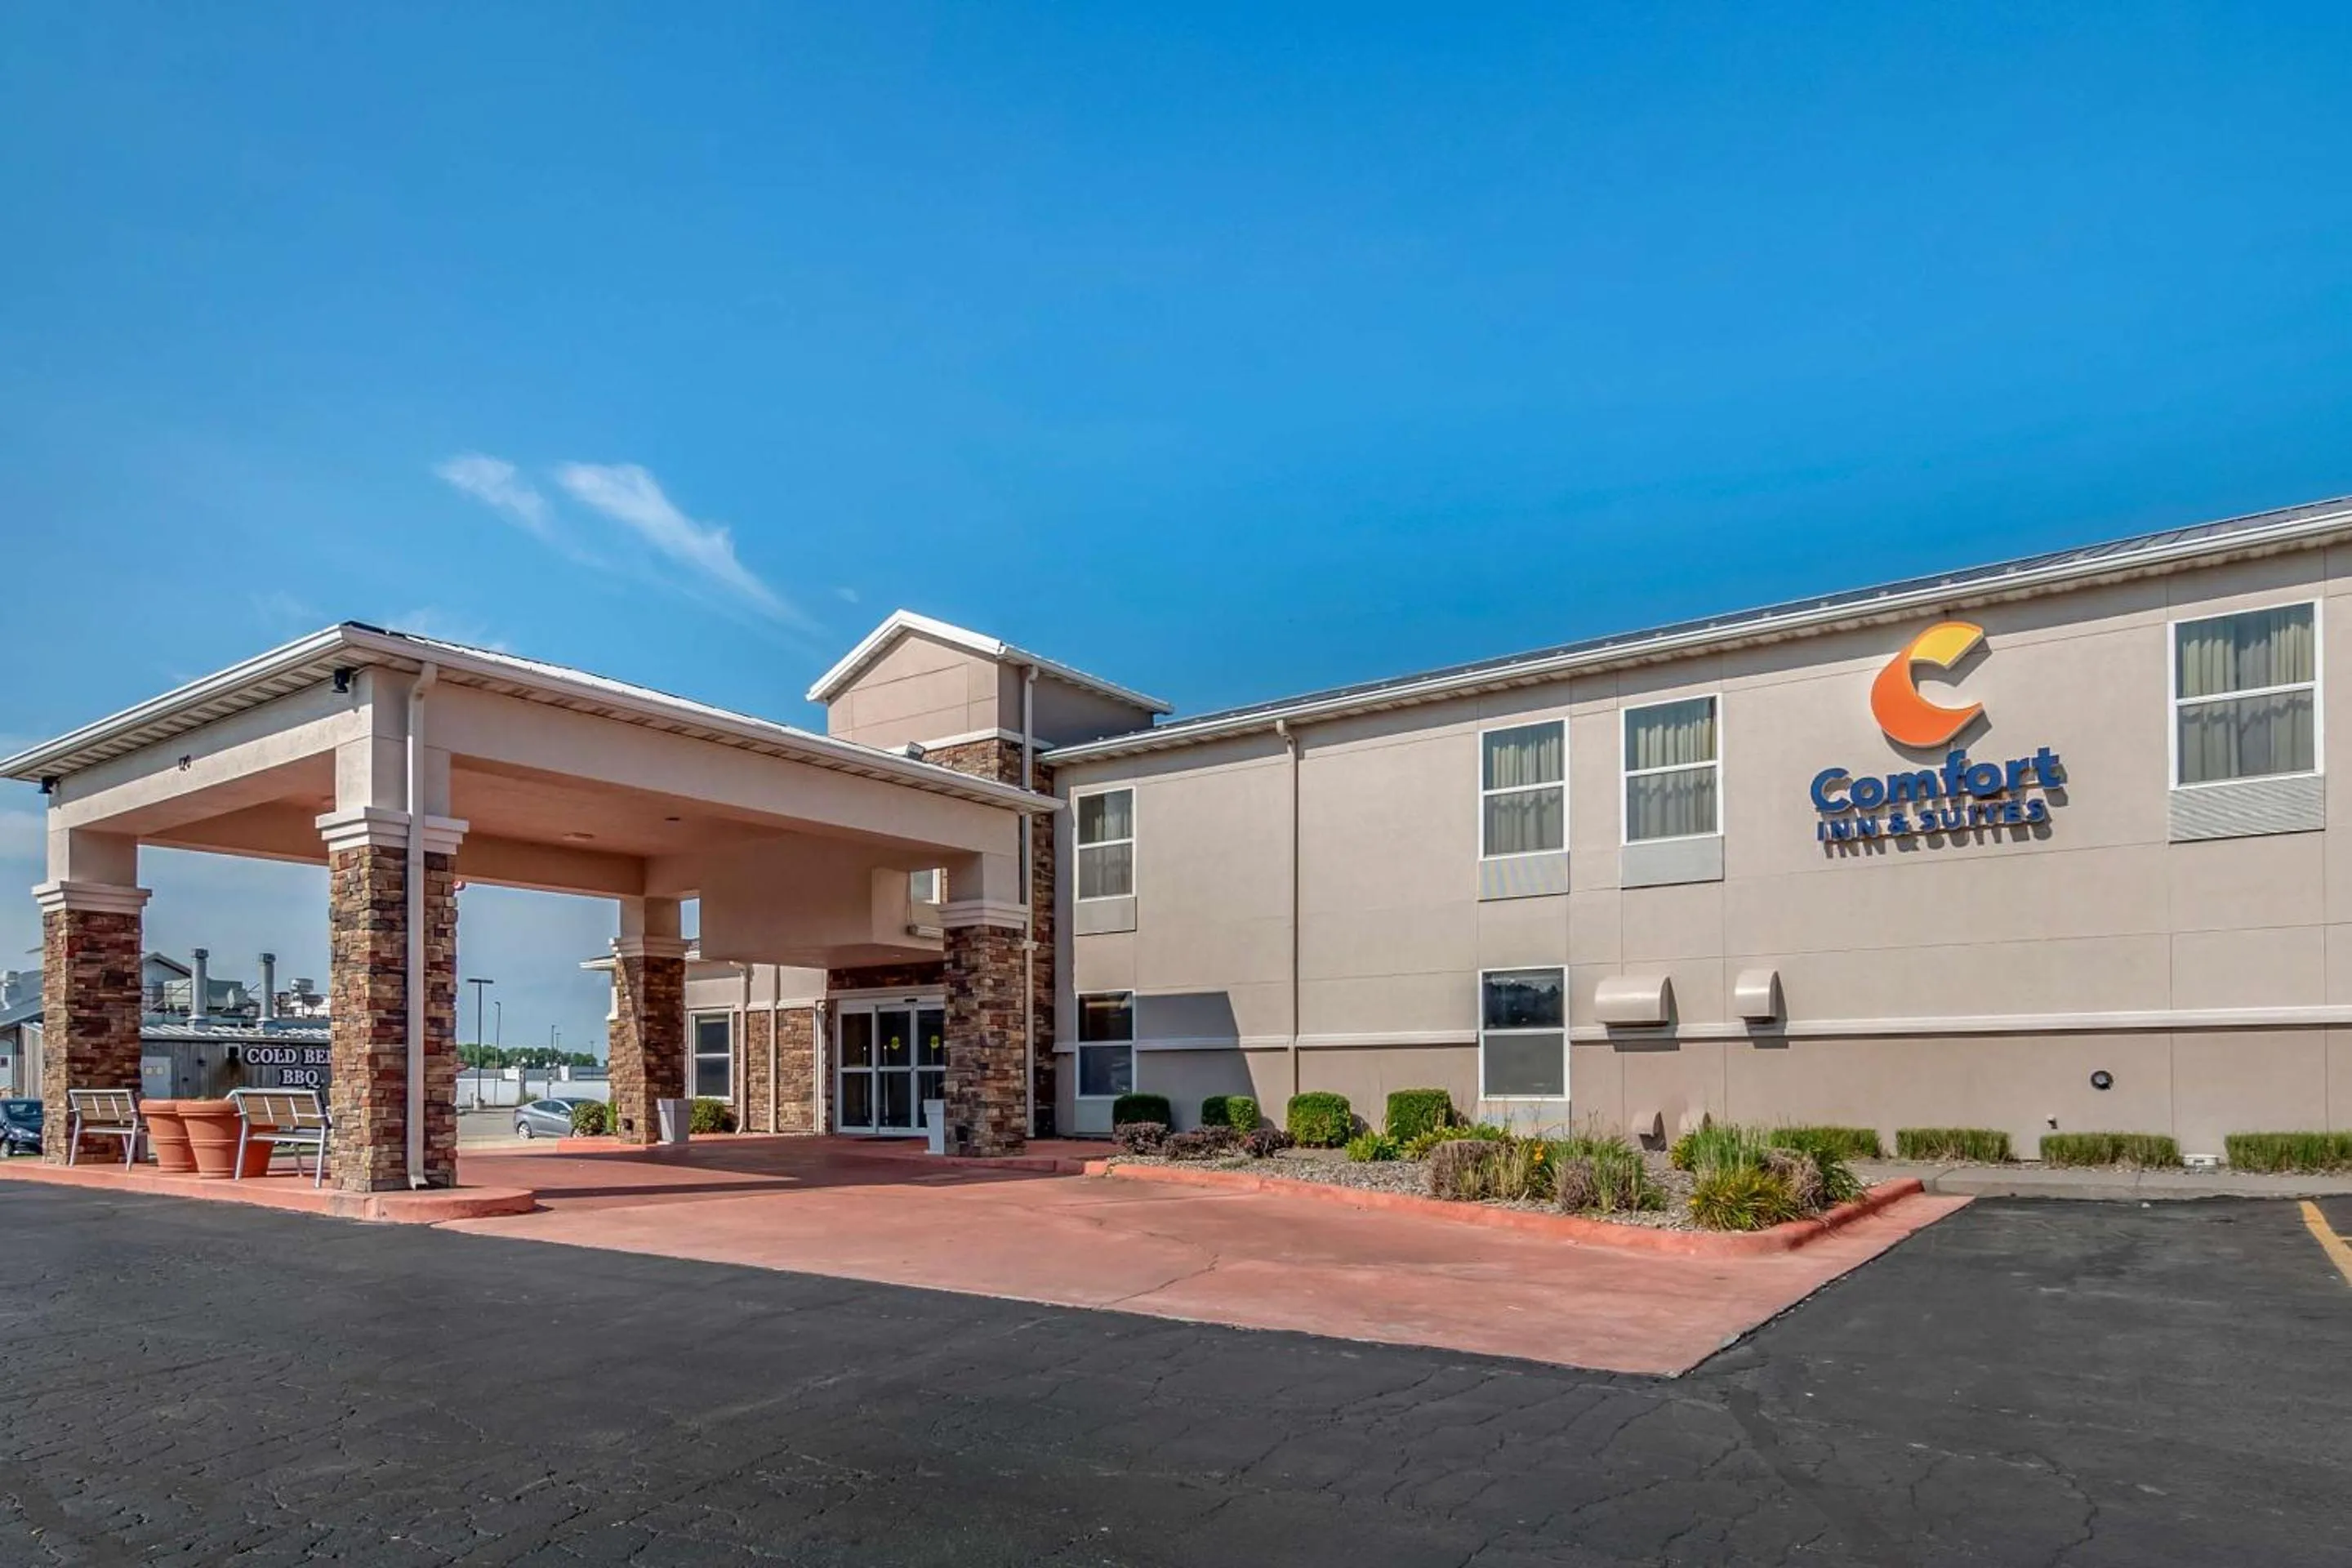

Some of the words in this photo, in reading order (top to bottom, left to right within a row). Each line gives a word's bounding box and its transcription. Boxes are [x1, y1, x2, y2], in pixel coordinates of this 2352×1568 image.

[1810, 747, 2061, 813] Comfort
[1816, 815, 1877, 841] INN
[1887, 812, 1909, 835] &
[1919, 798, 2046, 832] SUITES
[247, 1048, 297, 1063] COLD
